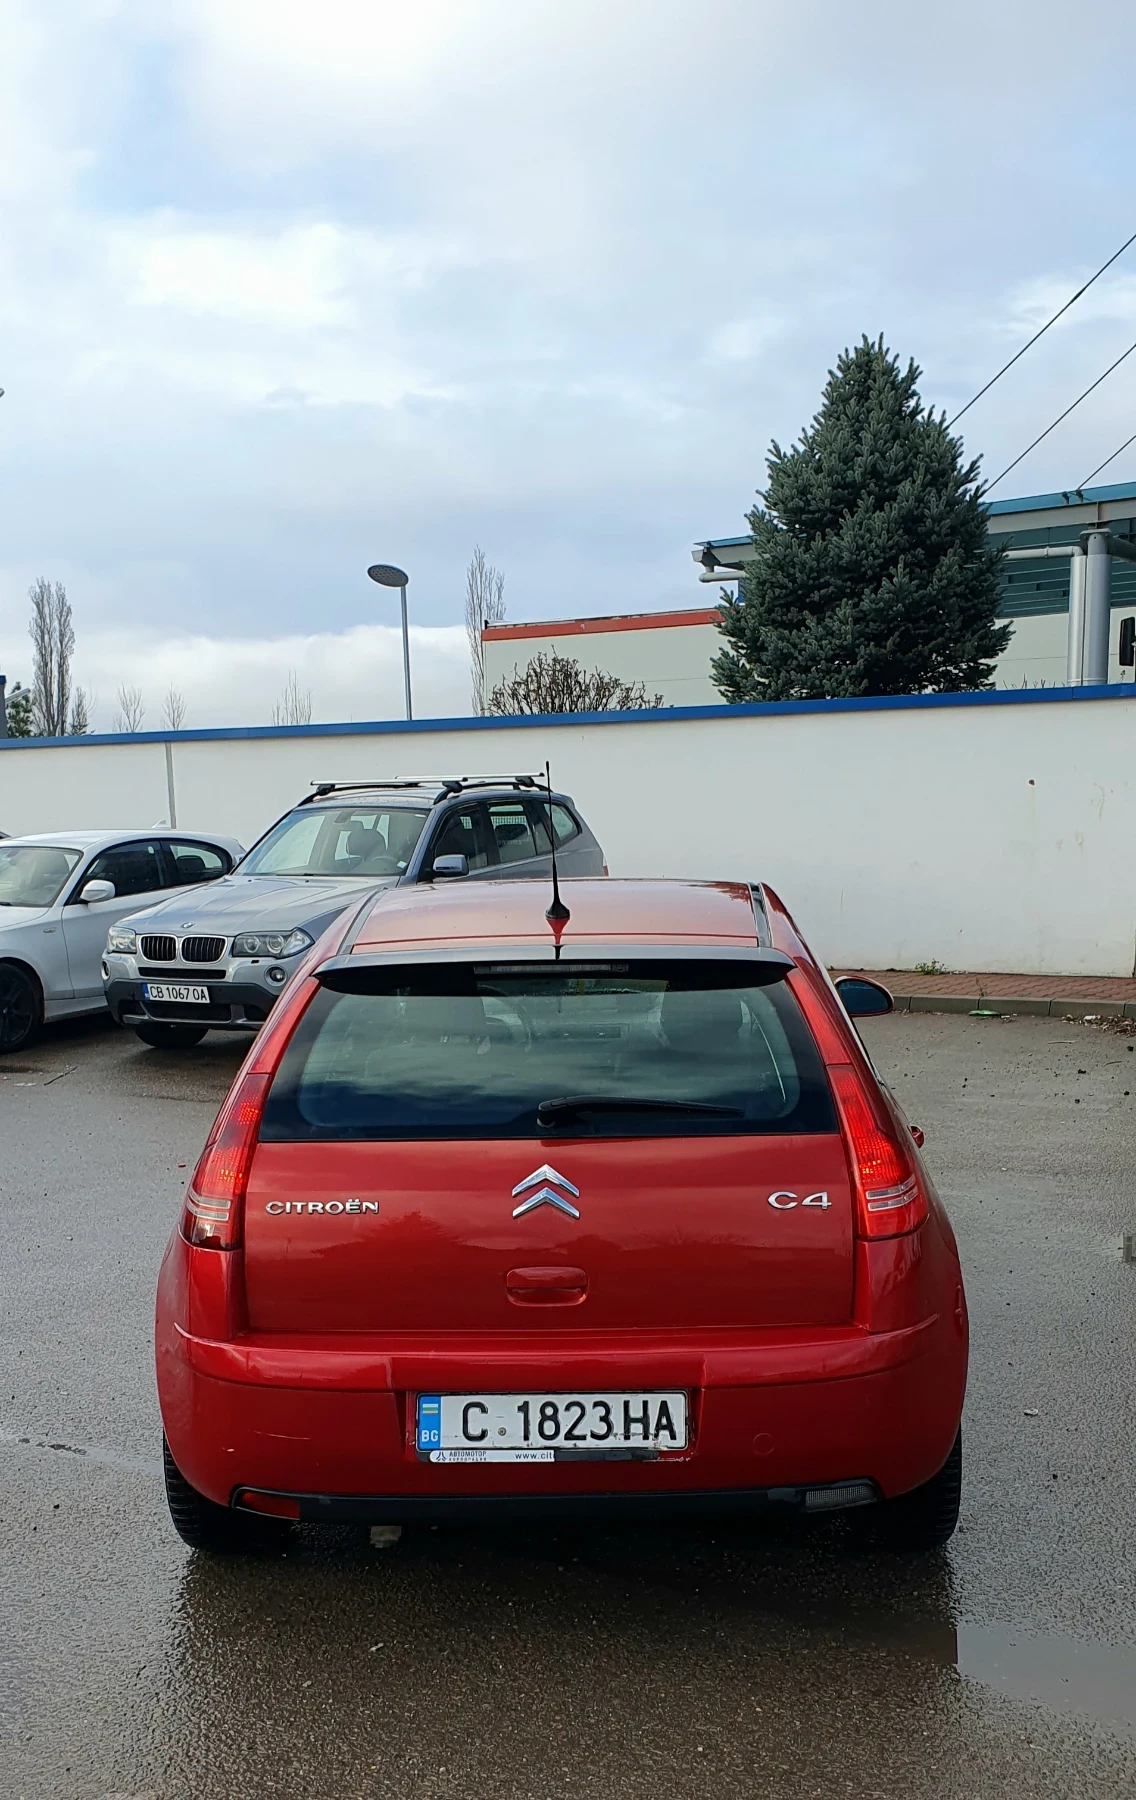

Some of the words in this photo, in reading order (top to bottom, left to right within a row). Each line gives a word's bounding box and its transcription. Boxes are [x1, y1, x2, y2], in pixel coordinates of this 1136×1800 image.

[166, 987, 190, 1001] 1067
[265, 1198, 379, 1215] CITROËN
[767, 1191, 832, 1210] C4
[421, 1430, 439, 1442] BG
